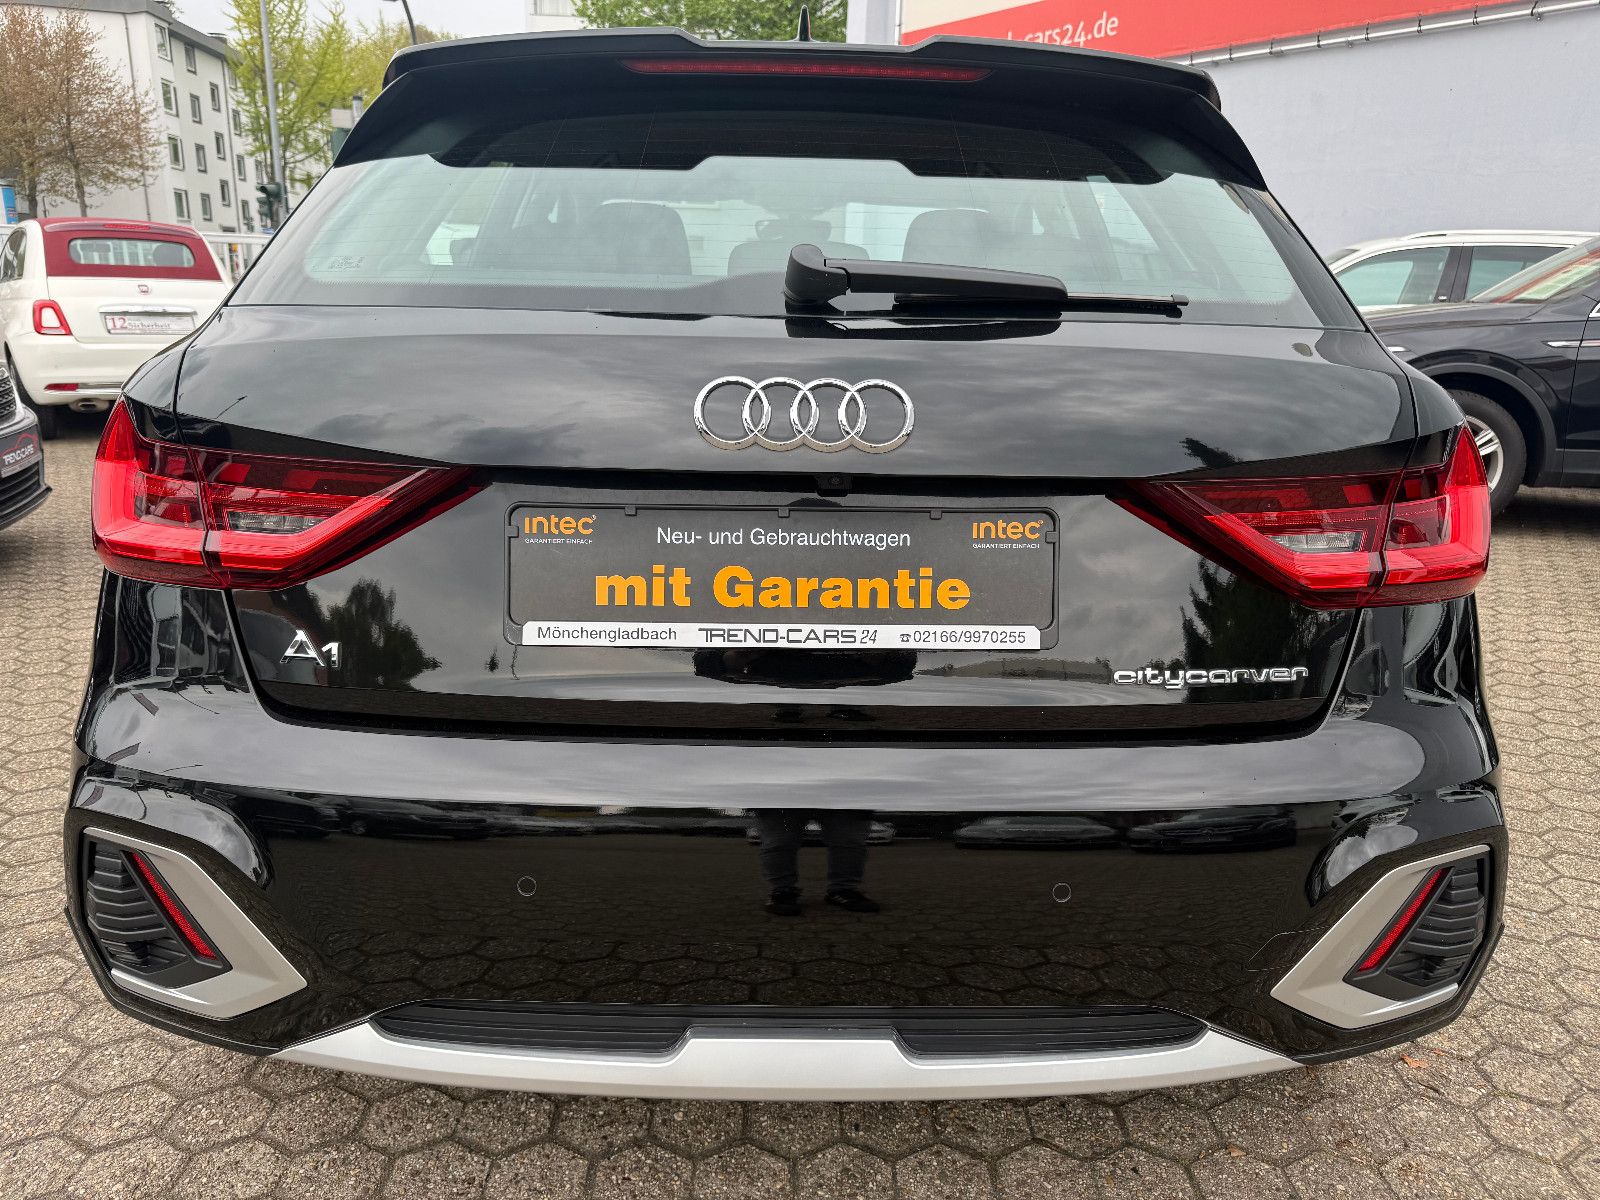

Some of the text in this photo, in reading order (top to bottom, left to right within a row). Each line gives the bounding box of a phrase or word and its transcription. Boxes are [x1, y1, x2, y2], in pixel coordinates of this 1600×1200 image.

[1007, 10, 1119, 48] ars24.de
[109, 317, 127, 329] 12
[656, 526, 912, 551] Neu- und Gebrauchtwagen
[595, 564, 971, 610] mit Garantie
[279, 629, 342, 668] A1
[537, 626, 677, 646] Mönchengladbach
[860, 629, 878, 645] 24
[913, 629, 1026, 644] 02166/9970255
[1113, 666, 1309, 690] citycarver
